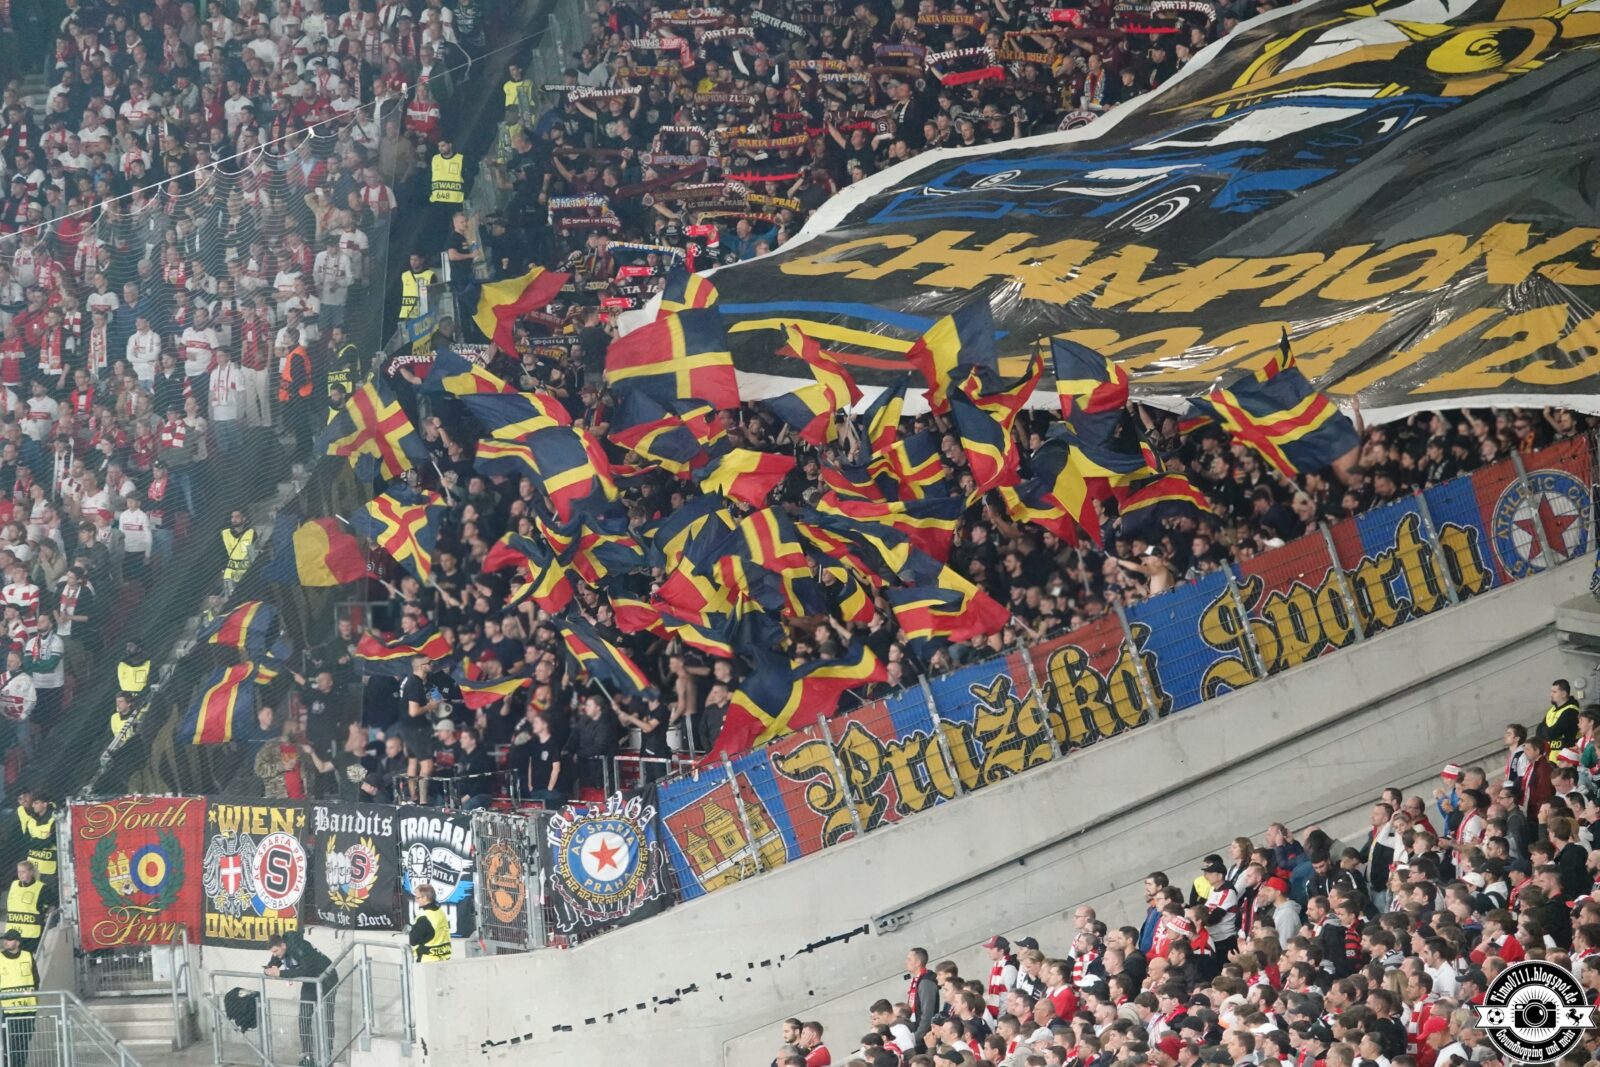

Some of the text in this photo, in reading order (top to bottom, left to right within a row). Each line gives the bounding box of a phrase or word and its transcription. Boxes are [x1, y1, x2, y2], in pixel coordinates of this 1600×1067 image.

[751, 10, 781, 28] SPARTA
[918, 15, 940, 24] PARTA
[432, 181, 462, 191] STEWARD
[436, 192, 450, 200] 648
[1198, 511, 1494, 703] Sparta
[80, 797, 203, 840] Youth
[217, 804, 295, 835] WIEN
[313, 806, 393, 837] Bandits
[571, 822, 635, 856] AC SPARTA
[411, 846, 426, 864] 19
[265, 848, 292, 893] S
[584, 871, 634, 893] PRAHA
